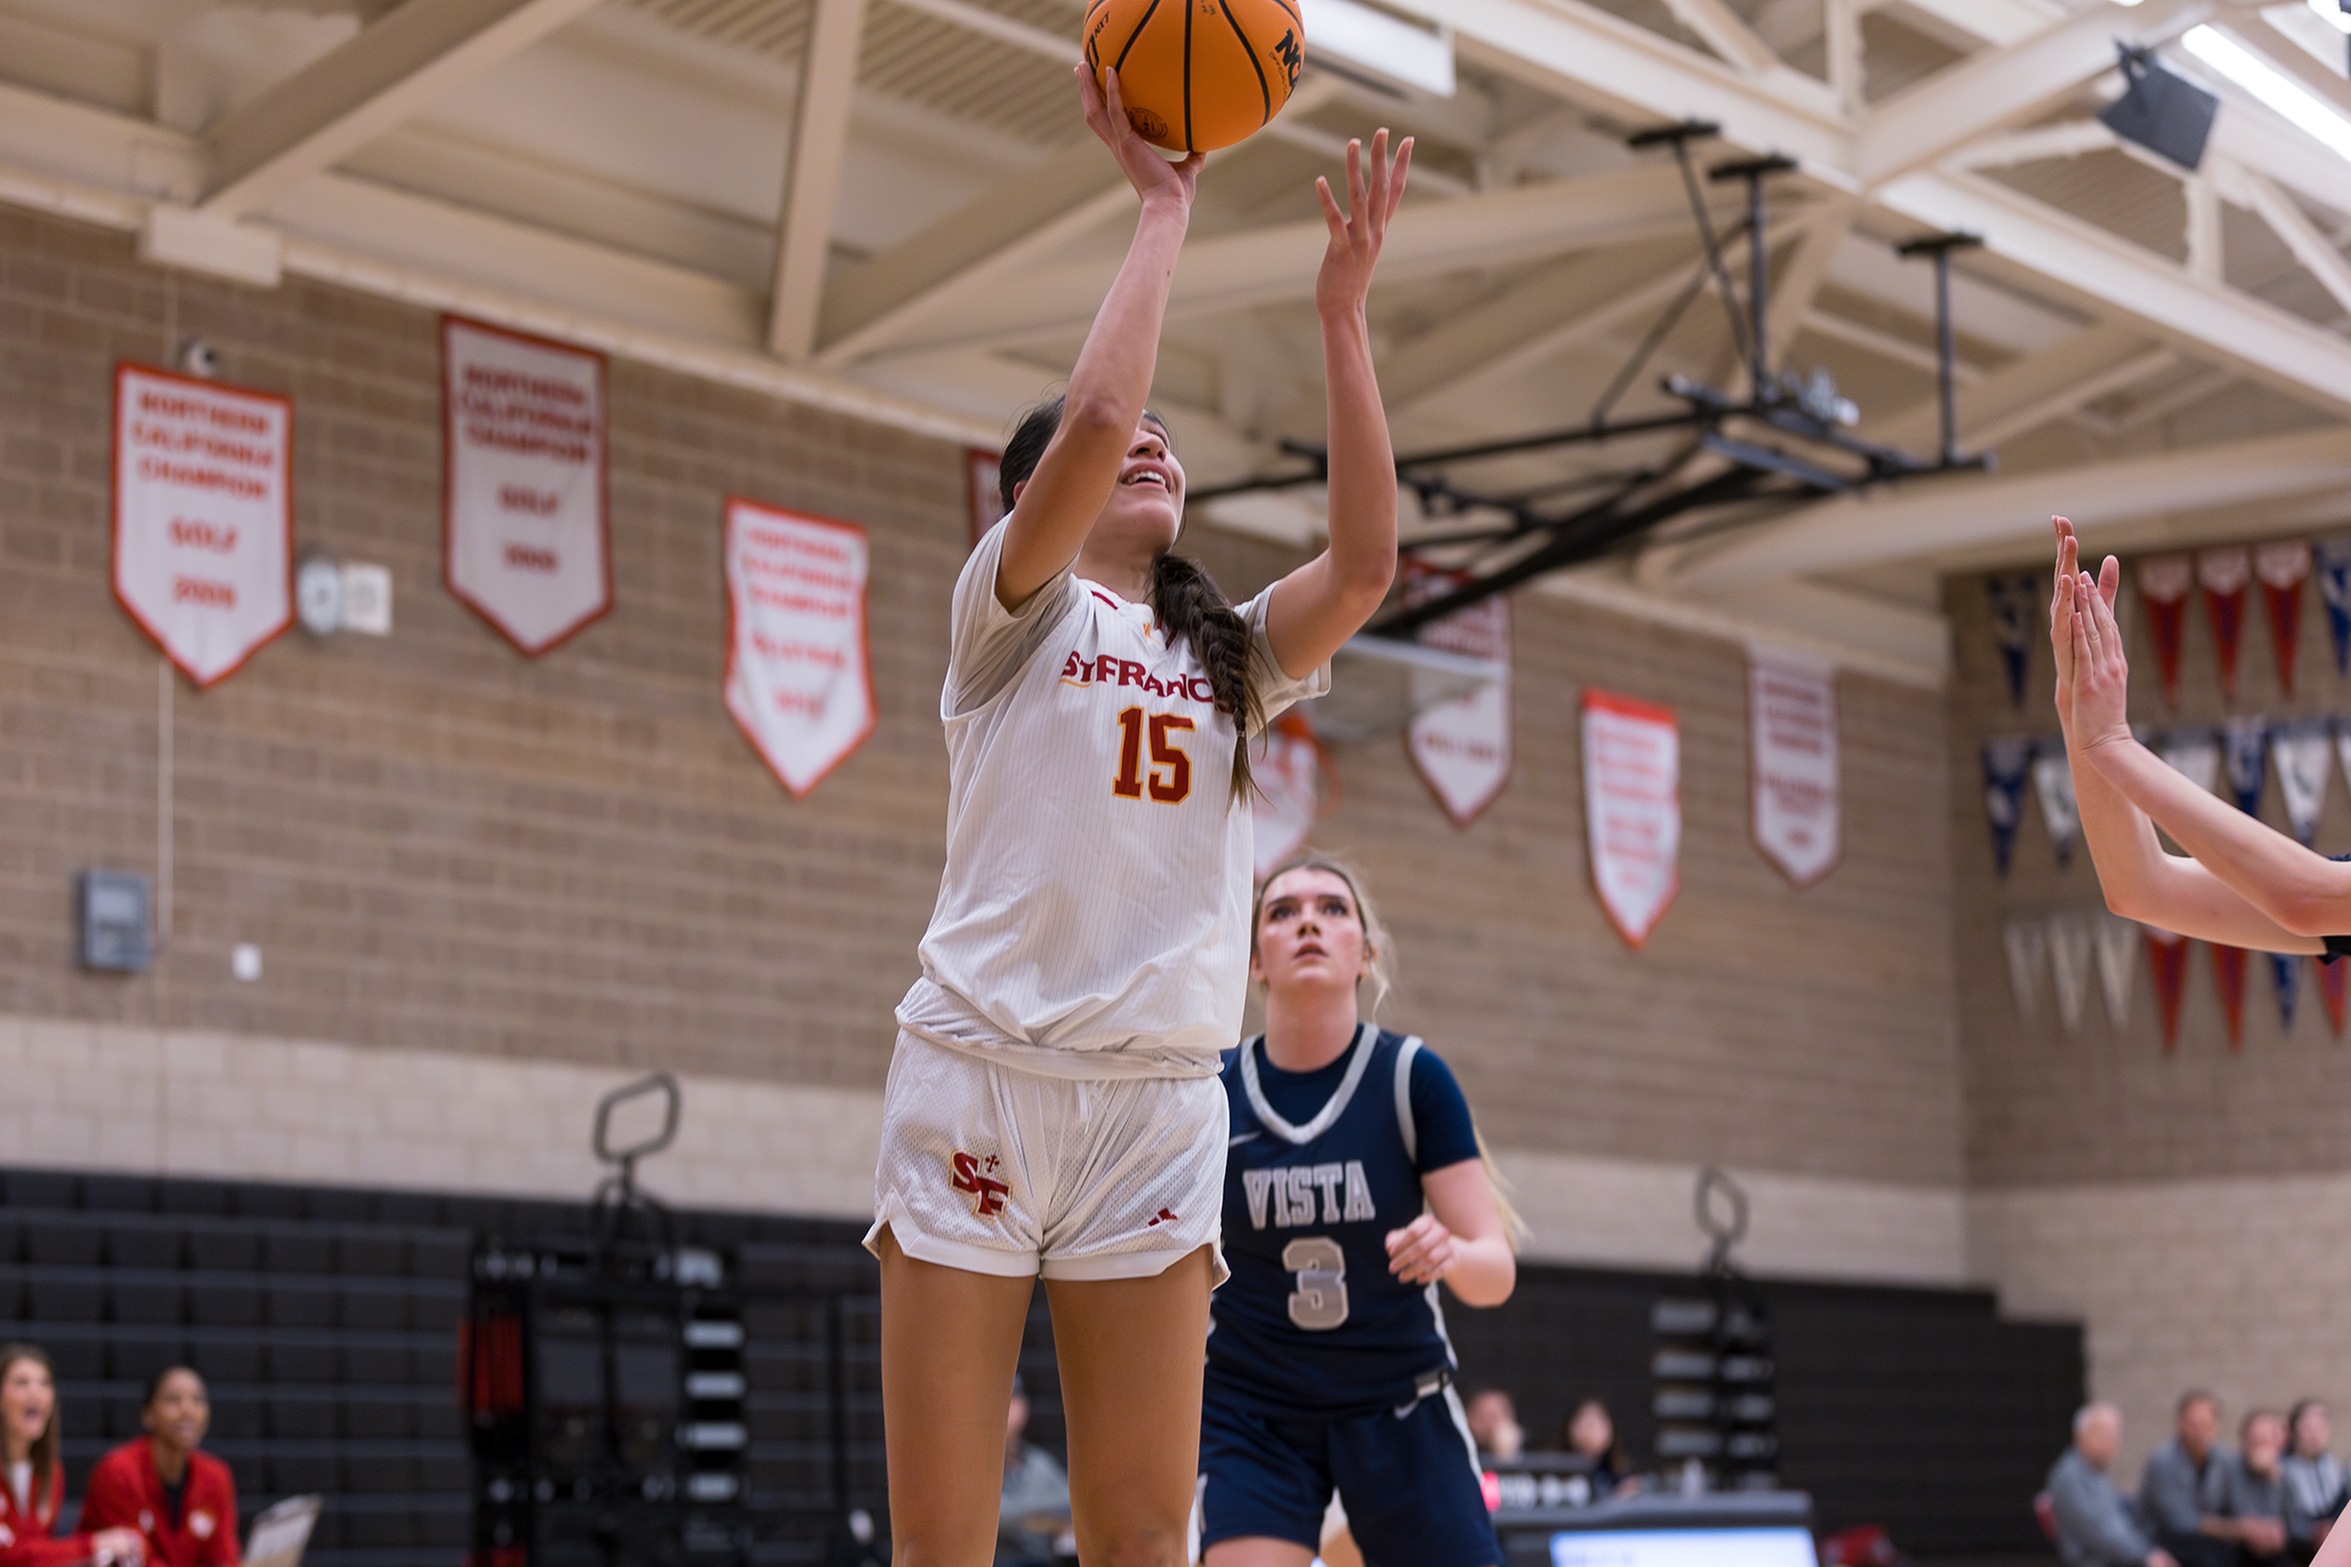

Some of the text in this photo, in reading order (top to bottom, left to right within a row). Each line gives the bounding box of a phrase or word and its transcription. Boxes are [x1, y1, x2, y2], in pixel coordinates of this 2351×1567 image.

[1094, 11, 1110, 38] NXT
[138, 392, 270, 435] NORTHERN
[131, 420, 274, 468] CALIFORNIA
[138, 457, 267, 501] CHAMPION
[167, 517, 237, 555] GOLF
[1096, 655, 1226, 711] FRANC
[1112, 705, 1195, 805] 15
[949, 1147, 1013, 1221] SF
[1243, 1160, 1376, 1230] VISTA
[1282, 1236, 1349, 1331] 3
